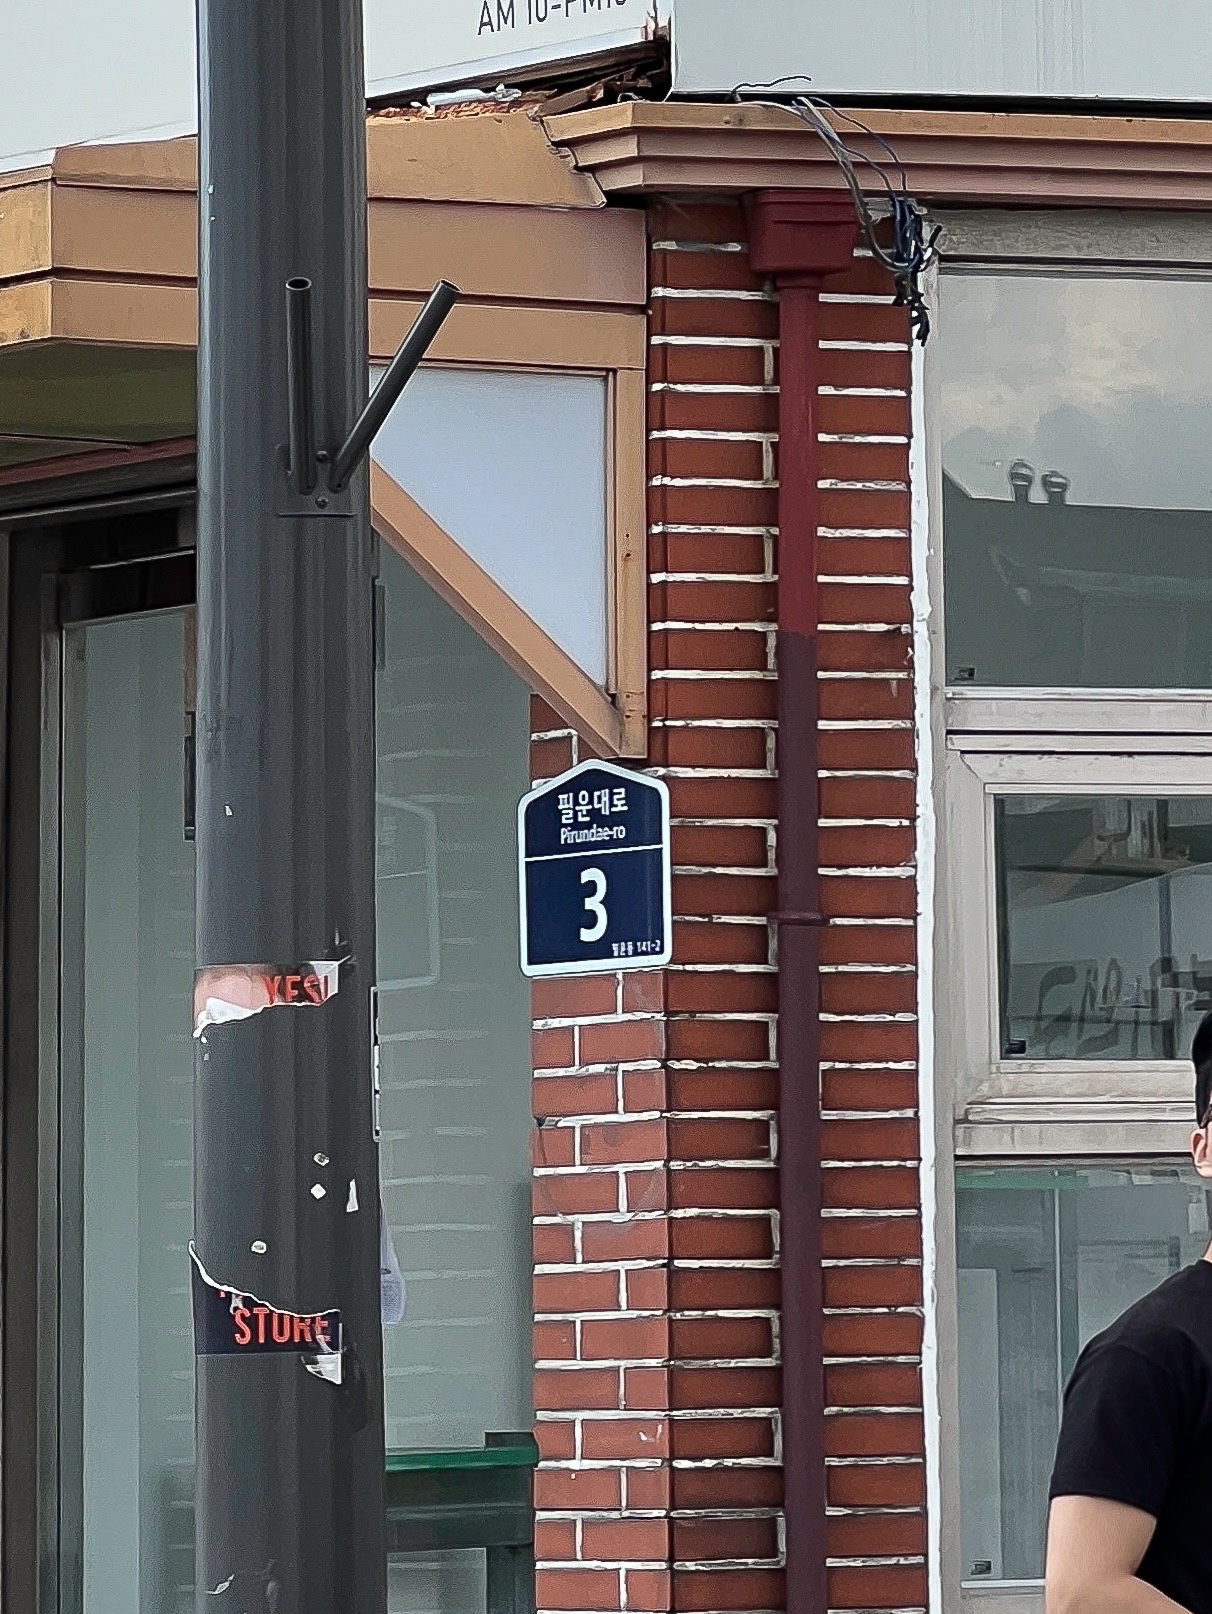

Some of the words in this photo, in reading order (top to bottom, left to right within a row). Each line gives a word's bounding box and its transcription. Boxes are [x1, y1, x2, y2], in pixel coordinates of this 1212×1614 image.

[478, 0, 515, 35] AM
[557, 787, 629, 824] 필운대로
[560, 824, 626, 845] Pirundae-ro
[579, 868, 608, 942] 3
